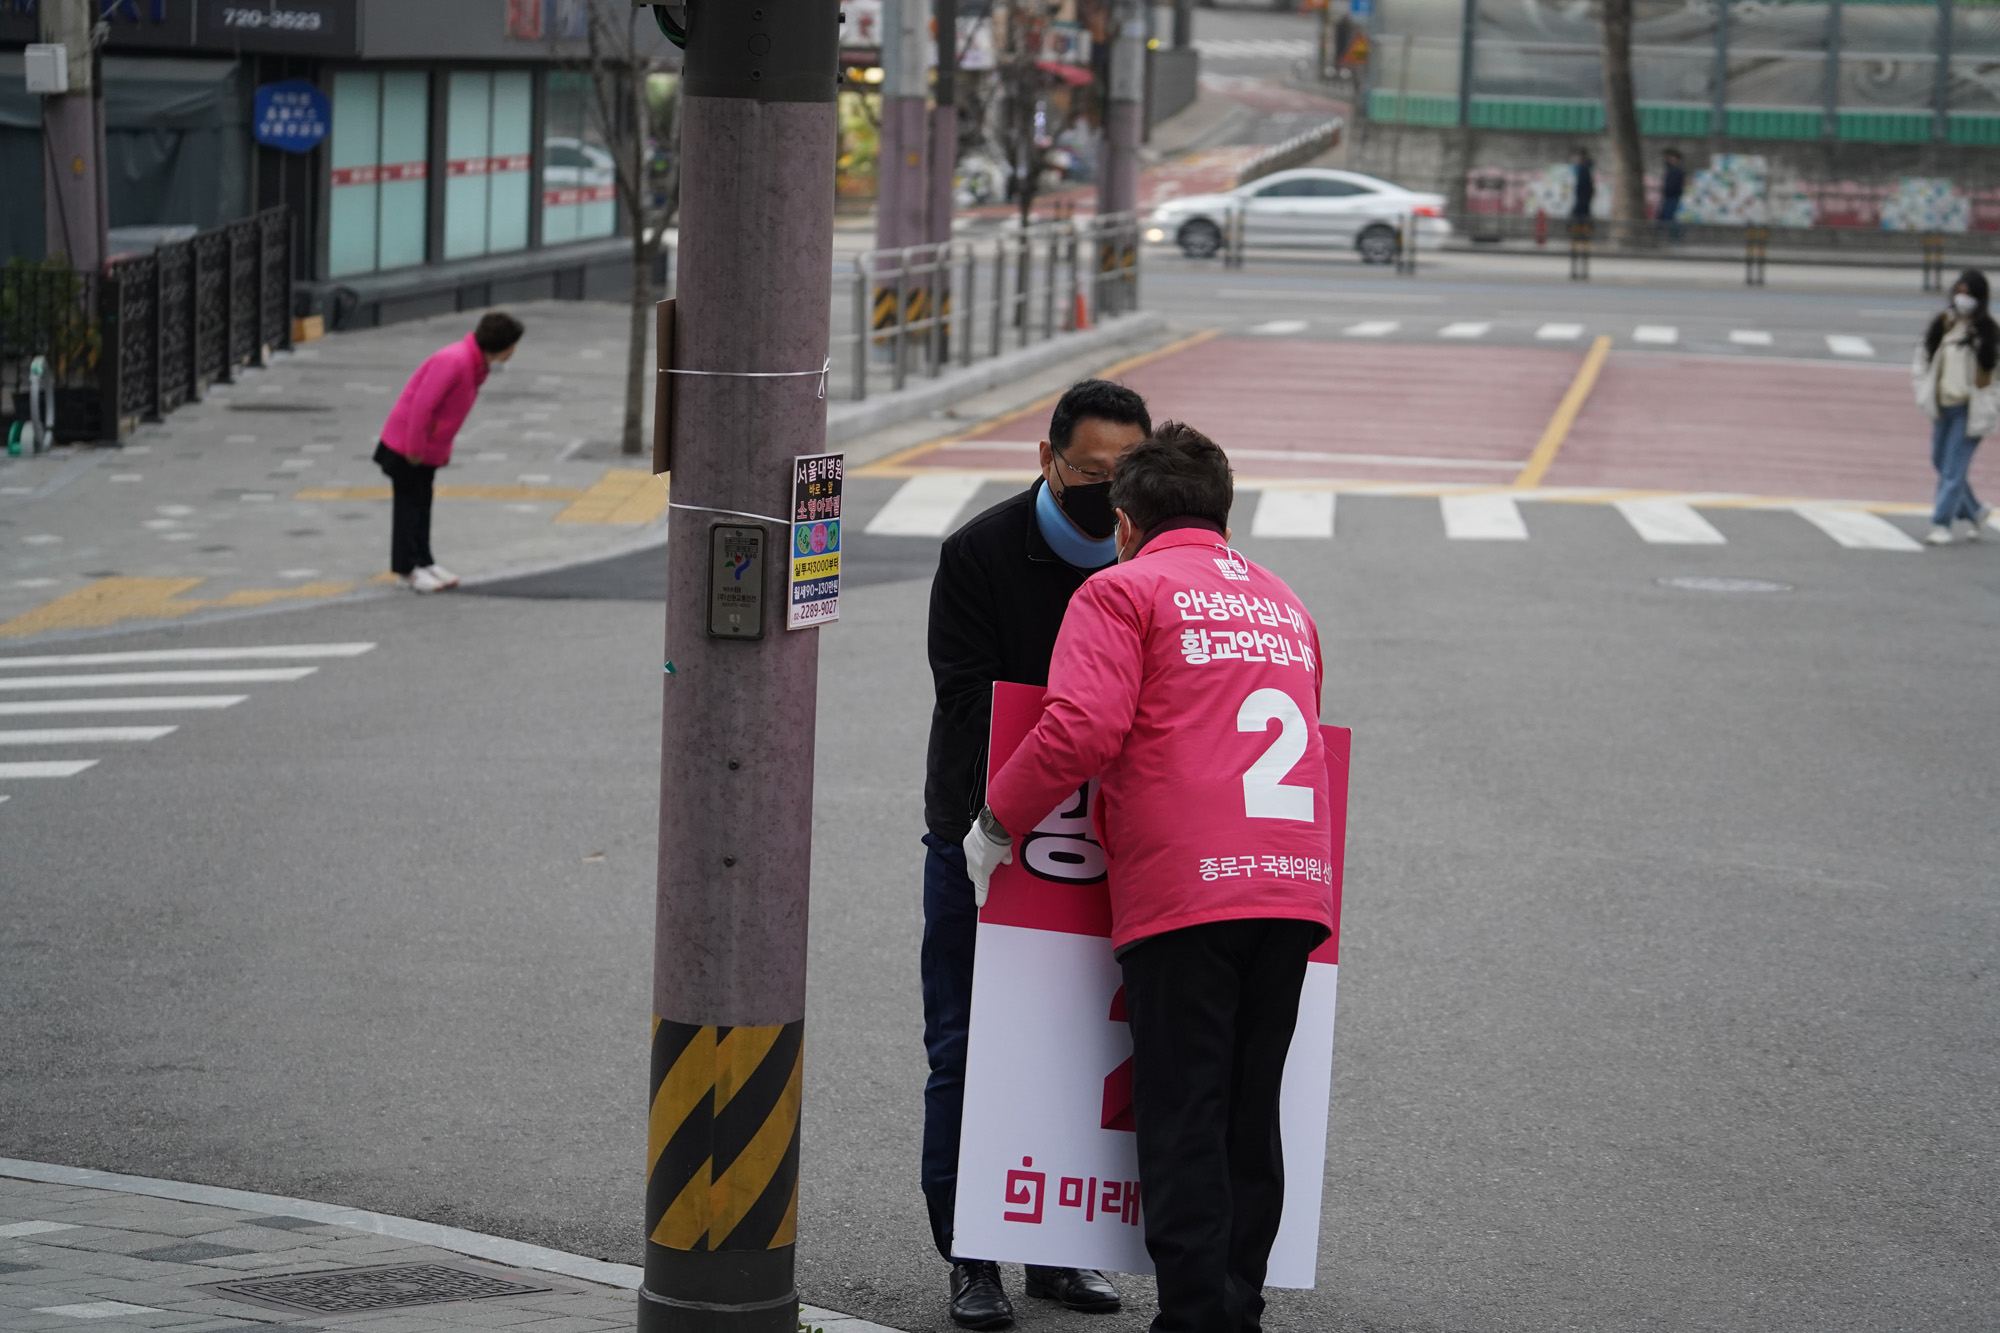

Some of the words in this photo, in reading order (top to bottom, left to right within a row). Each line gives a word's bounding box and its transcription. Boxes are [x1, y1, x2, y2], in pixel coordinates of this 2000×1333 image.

[797, 458, 844, 484] 서울대병원
[808, 483, 821, 496] 바로
[794, 557, 839, 577] 실투자3000부터
[793, 599, 837, 621] 02-2289-9027
[1236, 688, 1315, 824] 2
[1199, 855, 1258, 881] 종로구
[1260, 855, 1322, 882] 국회의원
